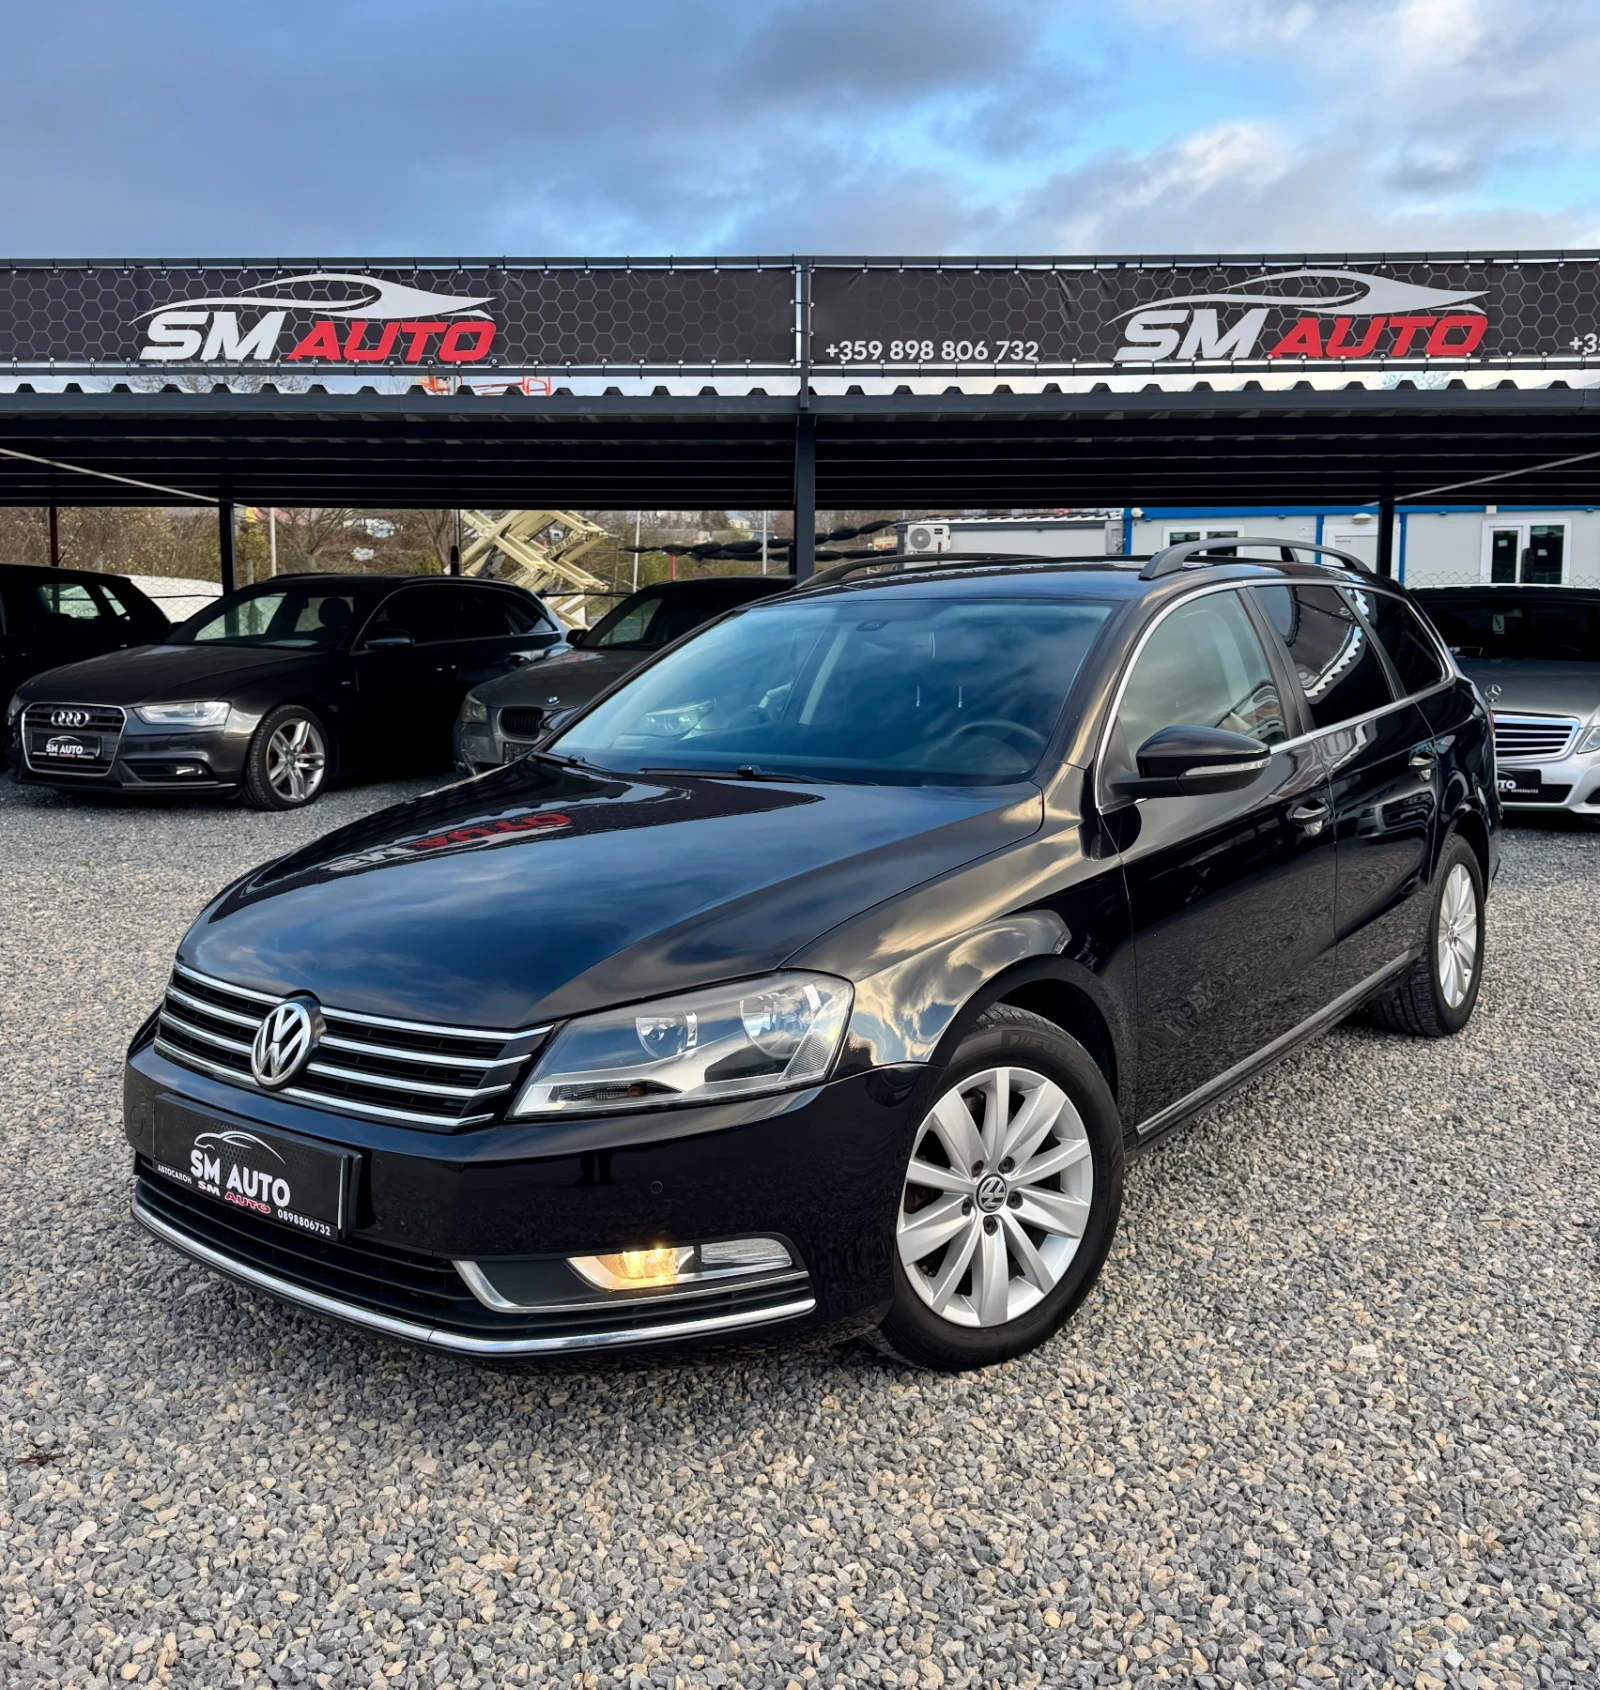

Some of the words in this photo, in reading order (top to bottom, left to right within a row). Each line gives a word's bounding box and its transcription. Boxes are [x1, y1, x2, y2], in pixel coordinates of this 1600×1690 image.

[139, 311, 287, 361] SM
[286, 320, 496, 362] AUTO
[825, 340, 883, 361] +359
[889, 340, 934, 361] 898
[941, 340, 988, 361] 806
[995, 340, 1039, 362] 732
[1114, 308, 1270, 360] SM
[1267, 316, 1488, 357] AUTO
[1569, 333, 1600, 353] +3
[46, 744, 58, 753] SM
[59, 745, 83, 754] AUTO
[1498, 780, 1516, 789] TO
[190, 1149, 221, 1185] SM
[225, 1163, 291, 1207] AUTO
[157, 1164, 192, 1185] АВТОСАЛОН
[197, 1180, 221, 1197] SM
[225, 1191, 271, 1214] AUTO
[277, 1208, 331, 1237] 0898806732
